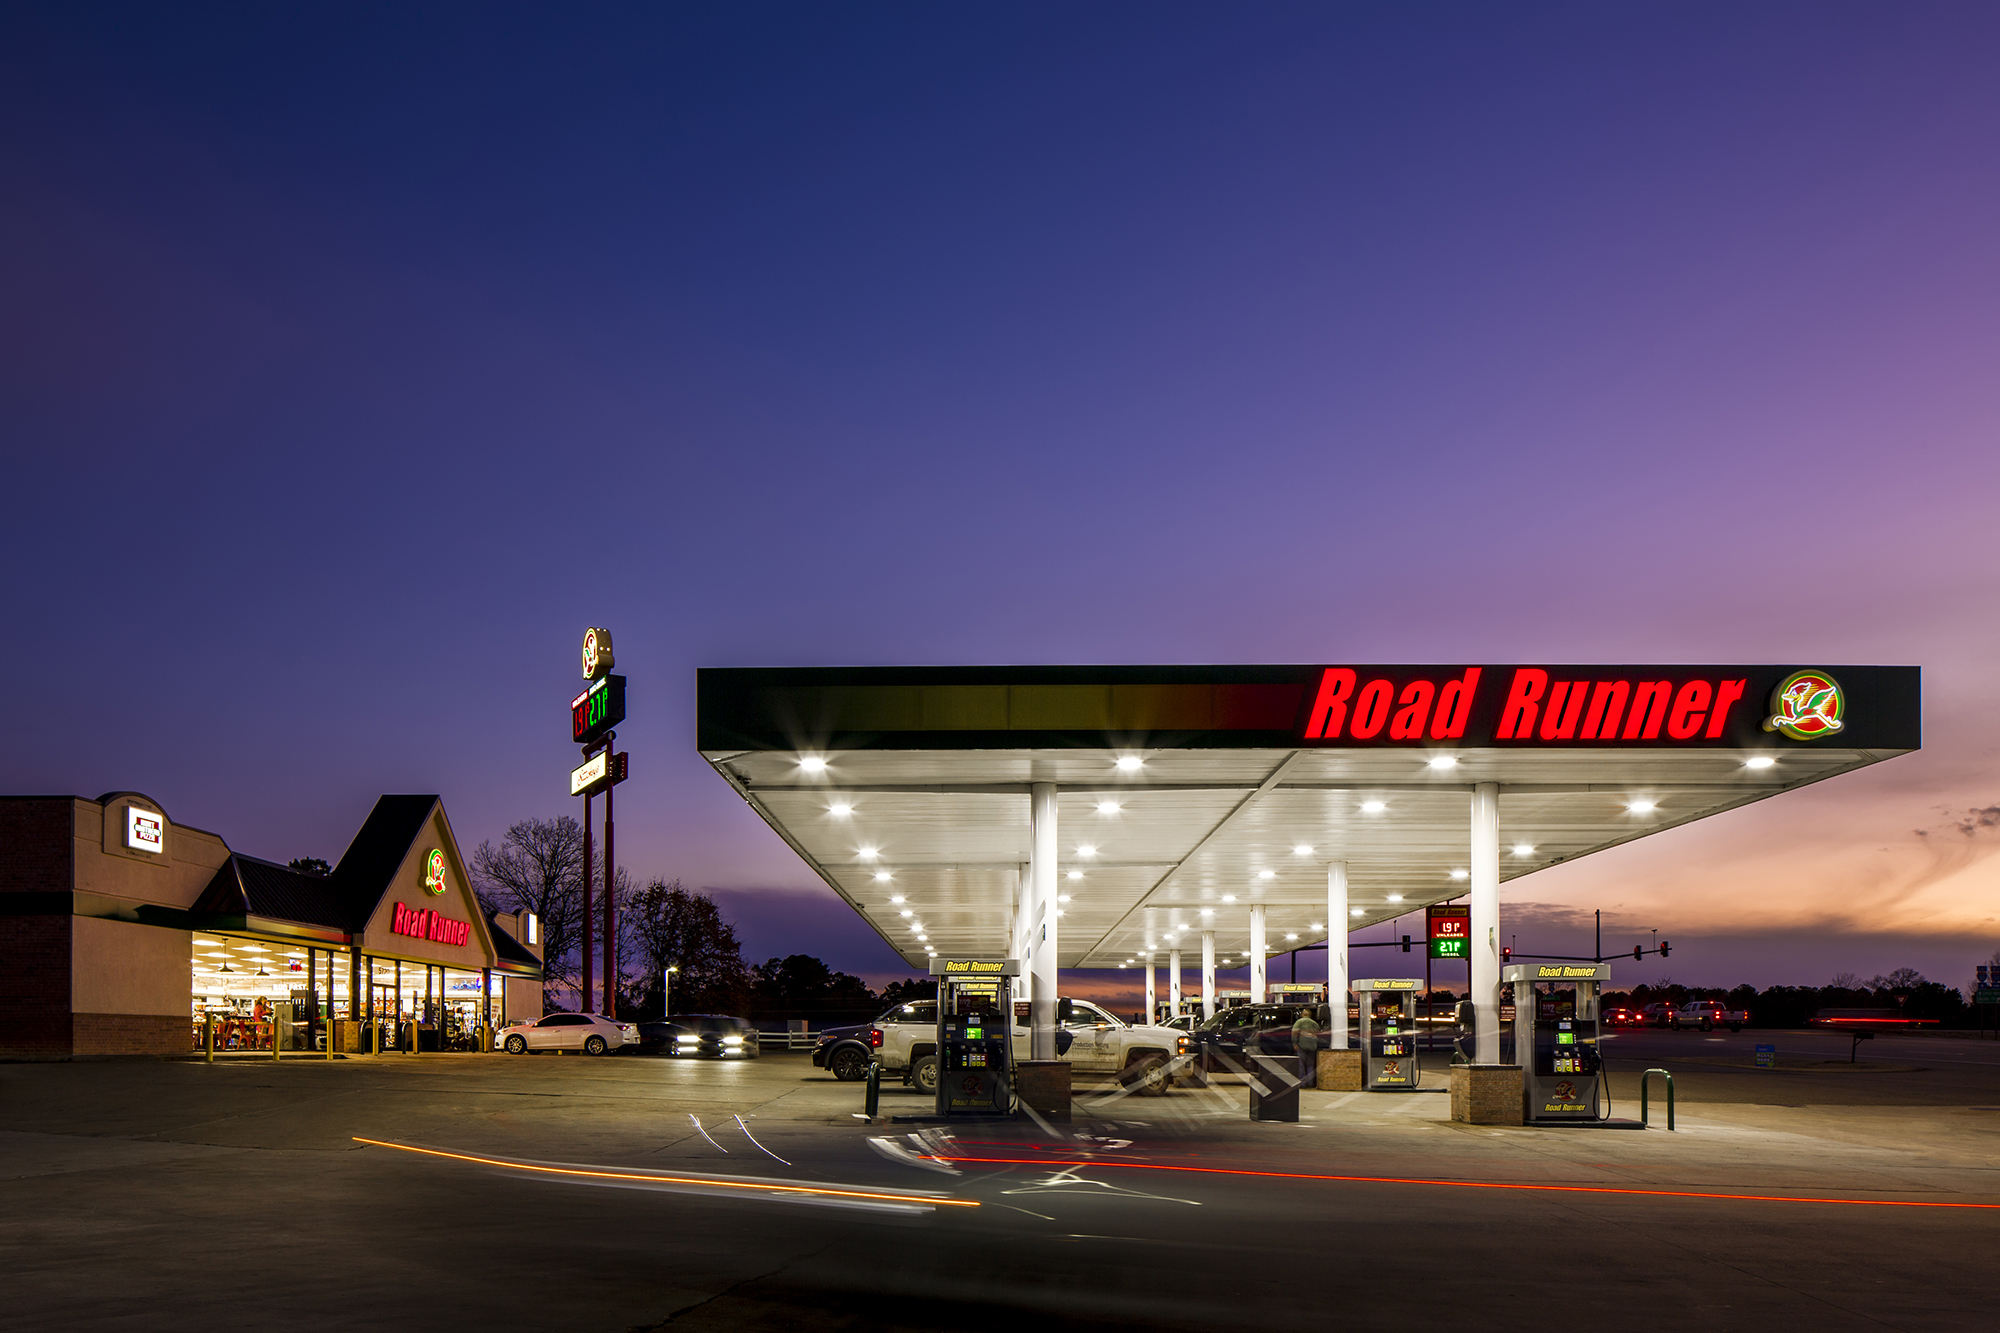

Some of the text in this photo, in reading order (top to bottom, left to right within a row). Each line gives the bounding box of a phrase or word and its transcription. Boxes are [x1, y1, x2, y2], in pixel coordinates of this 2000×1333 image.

[1304, 667, 1747, 740] Road Runner
[394, 902, 471, 946] Road Runner
[945, 961, 1005, 973] Road Runner
[1538, 965, 1597, 977] Road Runner
[1373, 980, 1414, 989] Road Runner
[951, 1098, 993, 1107] Road Runner
[1545, 1103, 1586, 1112] Road Runner
